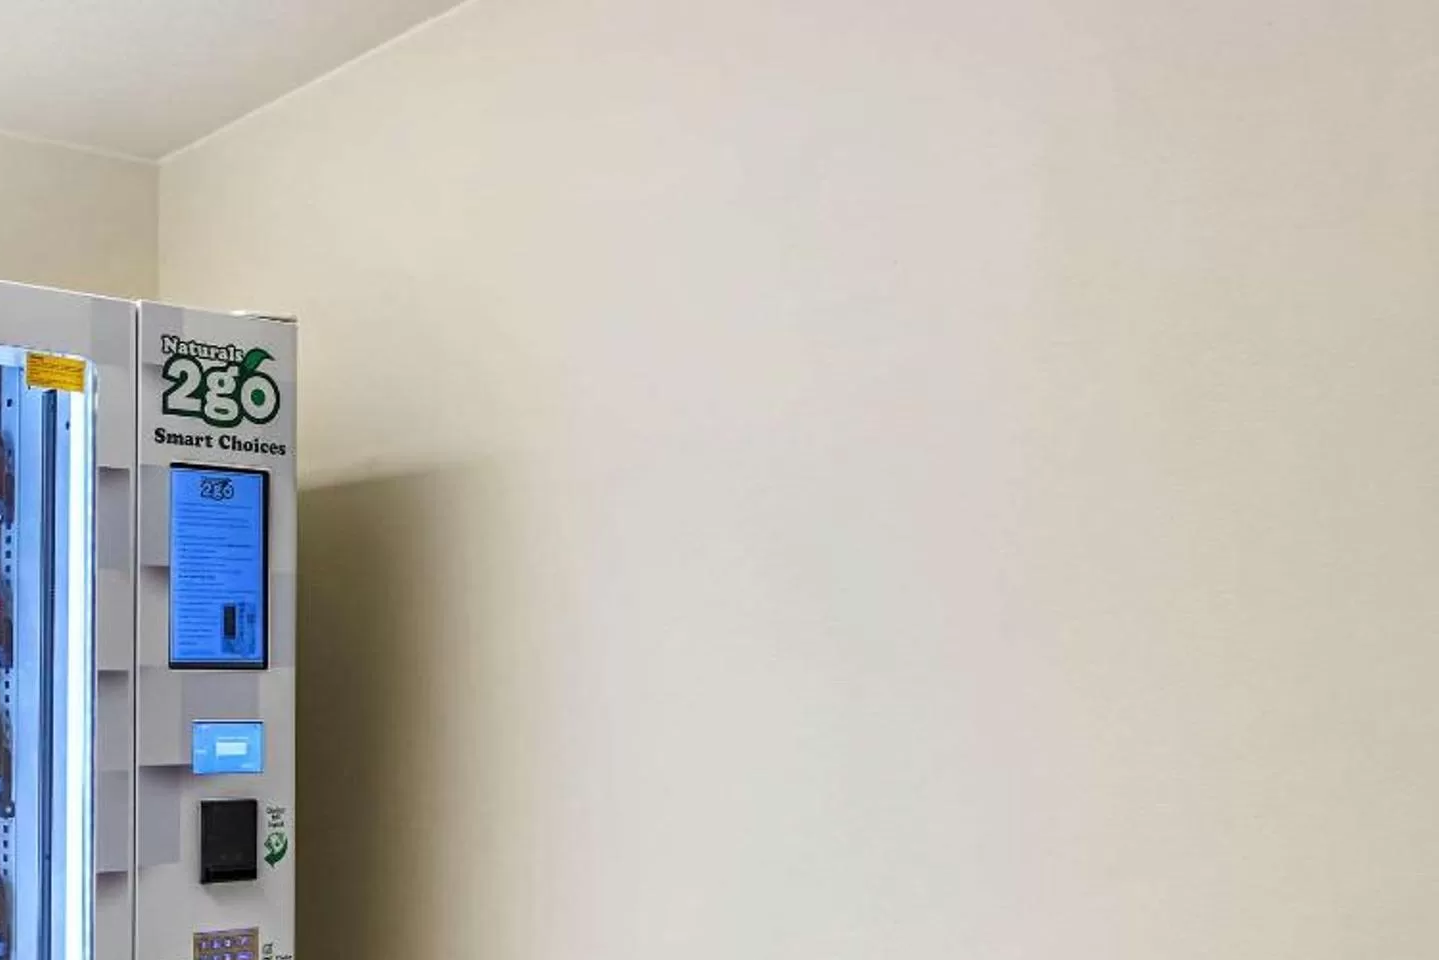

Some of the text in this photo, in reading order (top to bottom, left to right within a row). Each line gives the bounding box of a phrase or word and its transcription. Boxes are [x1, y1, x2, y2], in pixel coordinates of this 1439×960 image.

[161, 335, 244, 361] Naturals
[162, 352, 280, 428] 2go
[154, 428, 286, 455] Smart Choices
